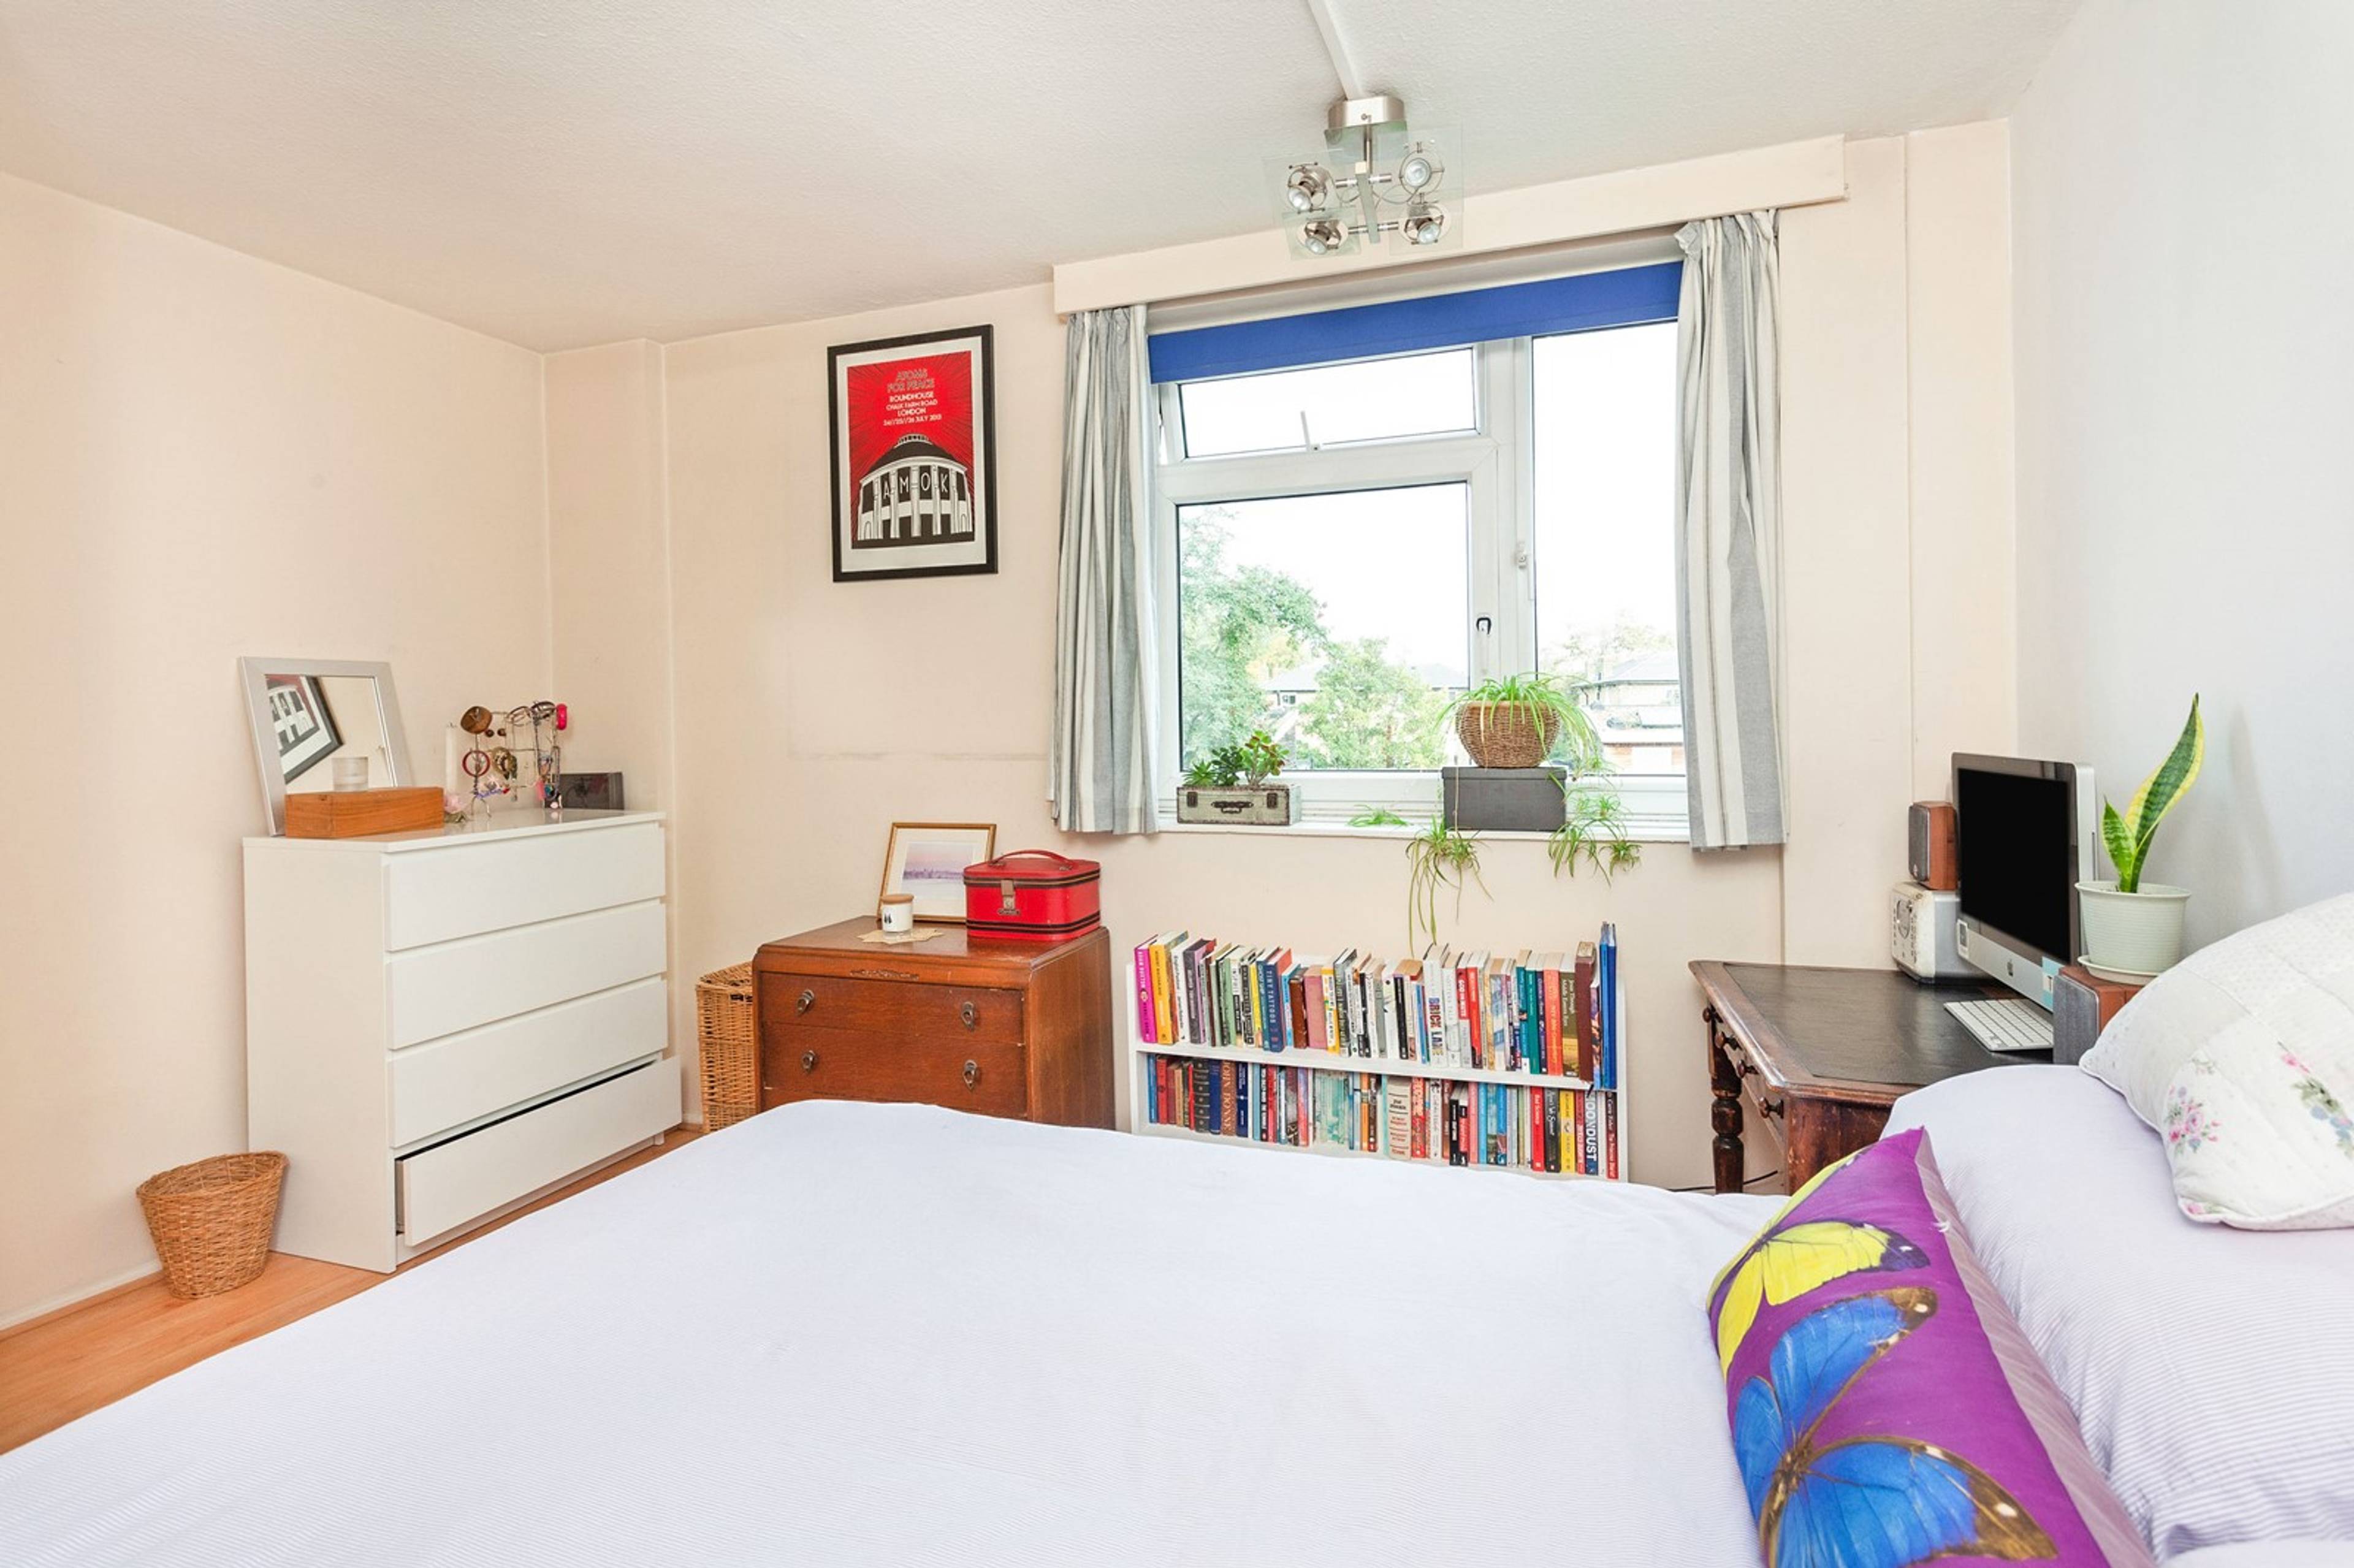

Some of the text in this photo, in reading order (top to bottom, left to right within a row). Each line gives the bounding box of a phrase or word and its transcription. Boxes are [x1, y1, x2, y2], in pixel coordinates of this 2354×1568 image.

[889, 391, 934, 403] ROUNDHOUSE
[921, 398, 938, 407] ROAD
[897, 407, 926, 417] LONDON
[883, 472, 948, 500] AMOK
[1268, 990, 1276, 1023] TATTOOS
[1428, 997, 1444, 1056] BRICK LANE
[1222, 1093, 1232, 1132] DONNE
